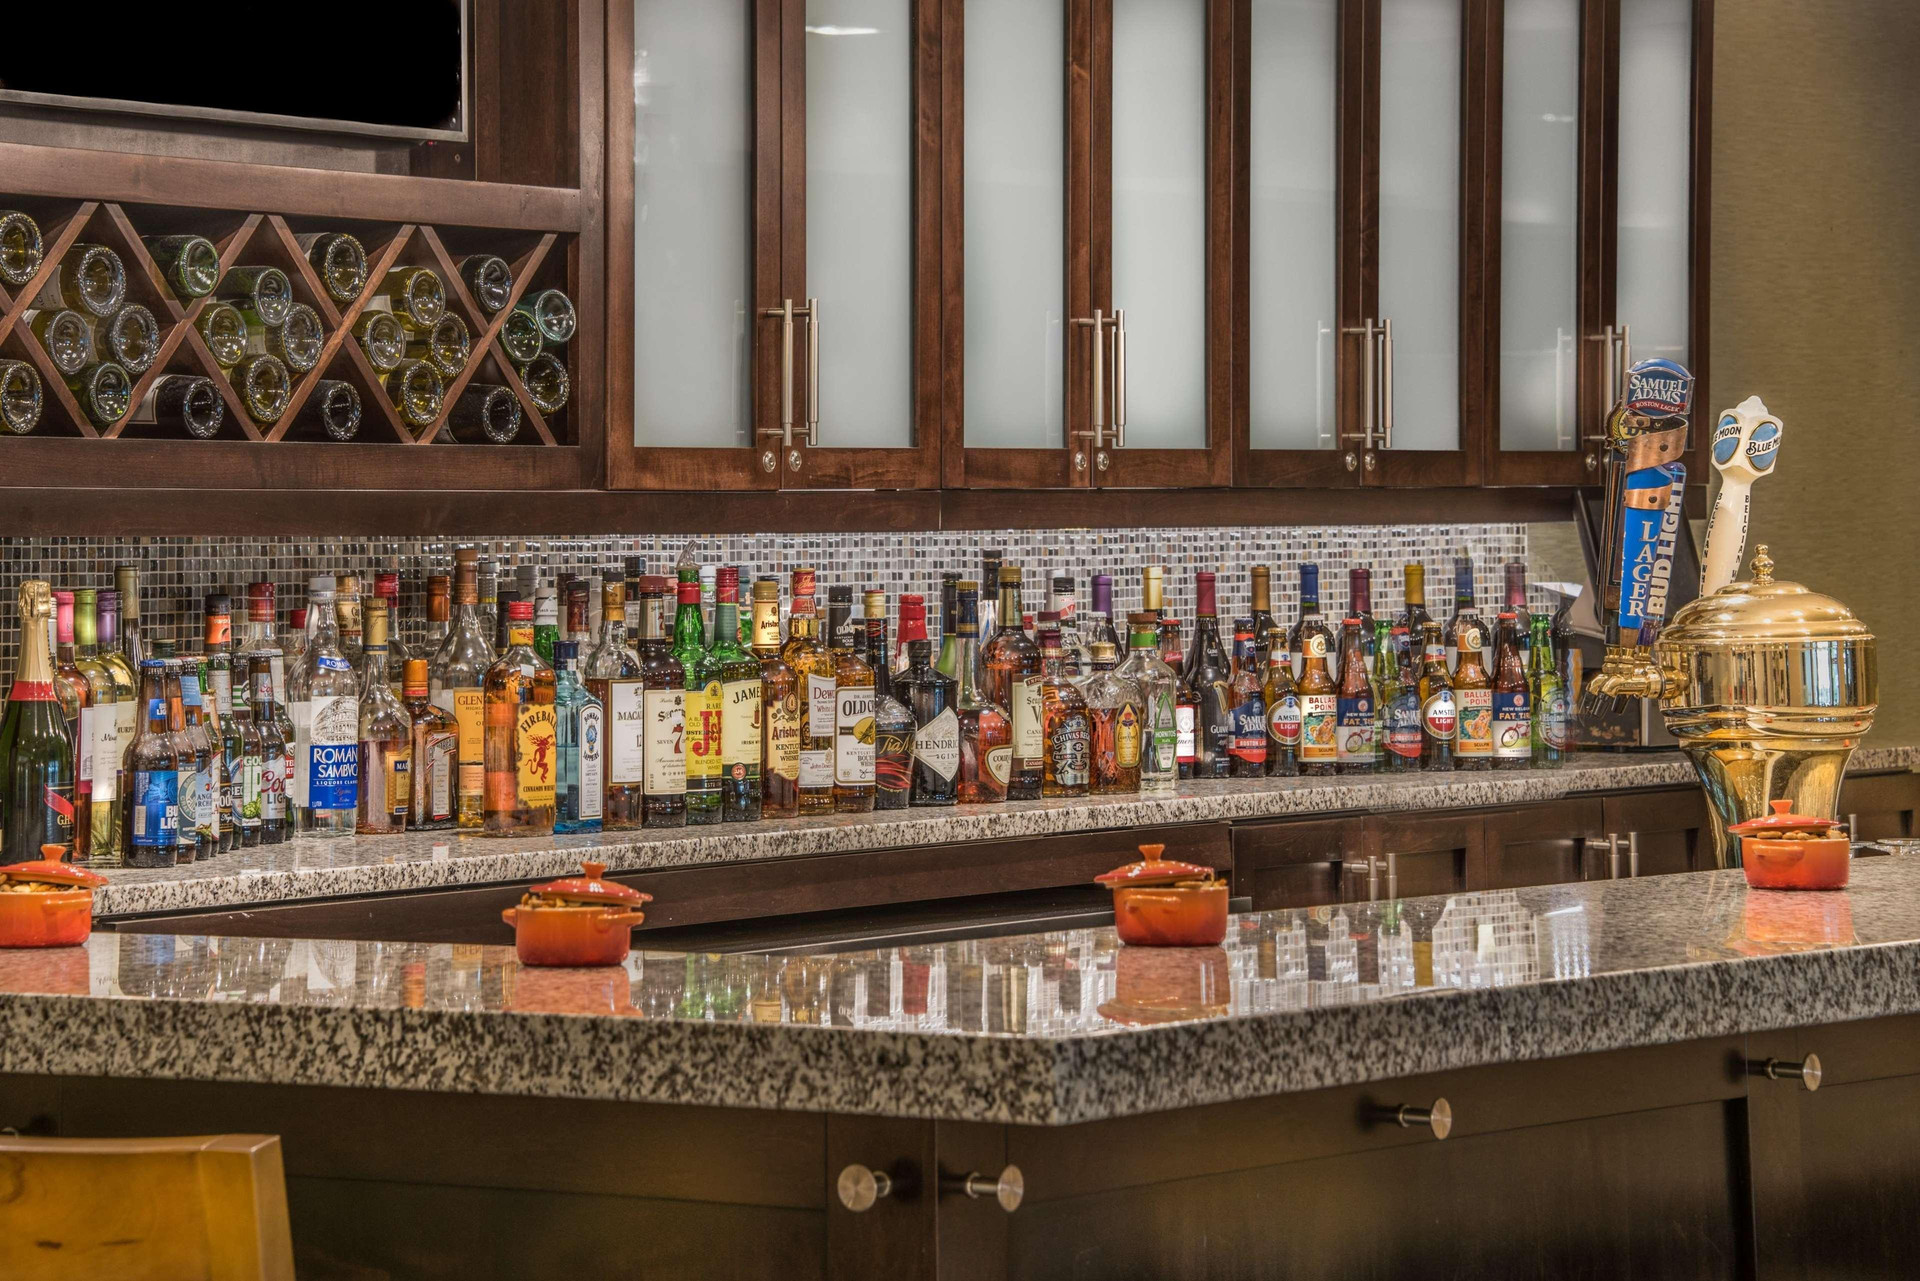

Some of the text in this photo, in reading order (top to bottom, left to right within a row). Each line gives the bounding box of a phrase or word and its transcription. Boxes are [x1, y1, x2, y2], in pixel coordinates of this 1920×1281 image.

[1630, 374, 1687, 393] SAMUEL
[1632, 388, 1681, 404] ADAMS
[1718, 426, 1742, 440] MOON
[1746, 441, 1772, 455] BLUE
[1704, 492, 1723, 558] BELGIAN
[1735, 494, 1750, 563] BELGIAN
[1627, 521, 1659, 617] LAGER
[1647, 558, 1672, 615] BUD
[843, 700, 866, 716] OLD
[672, 723, 684, 754] 7
[1053, 730, 1079, 744] CHIVAS
